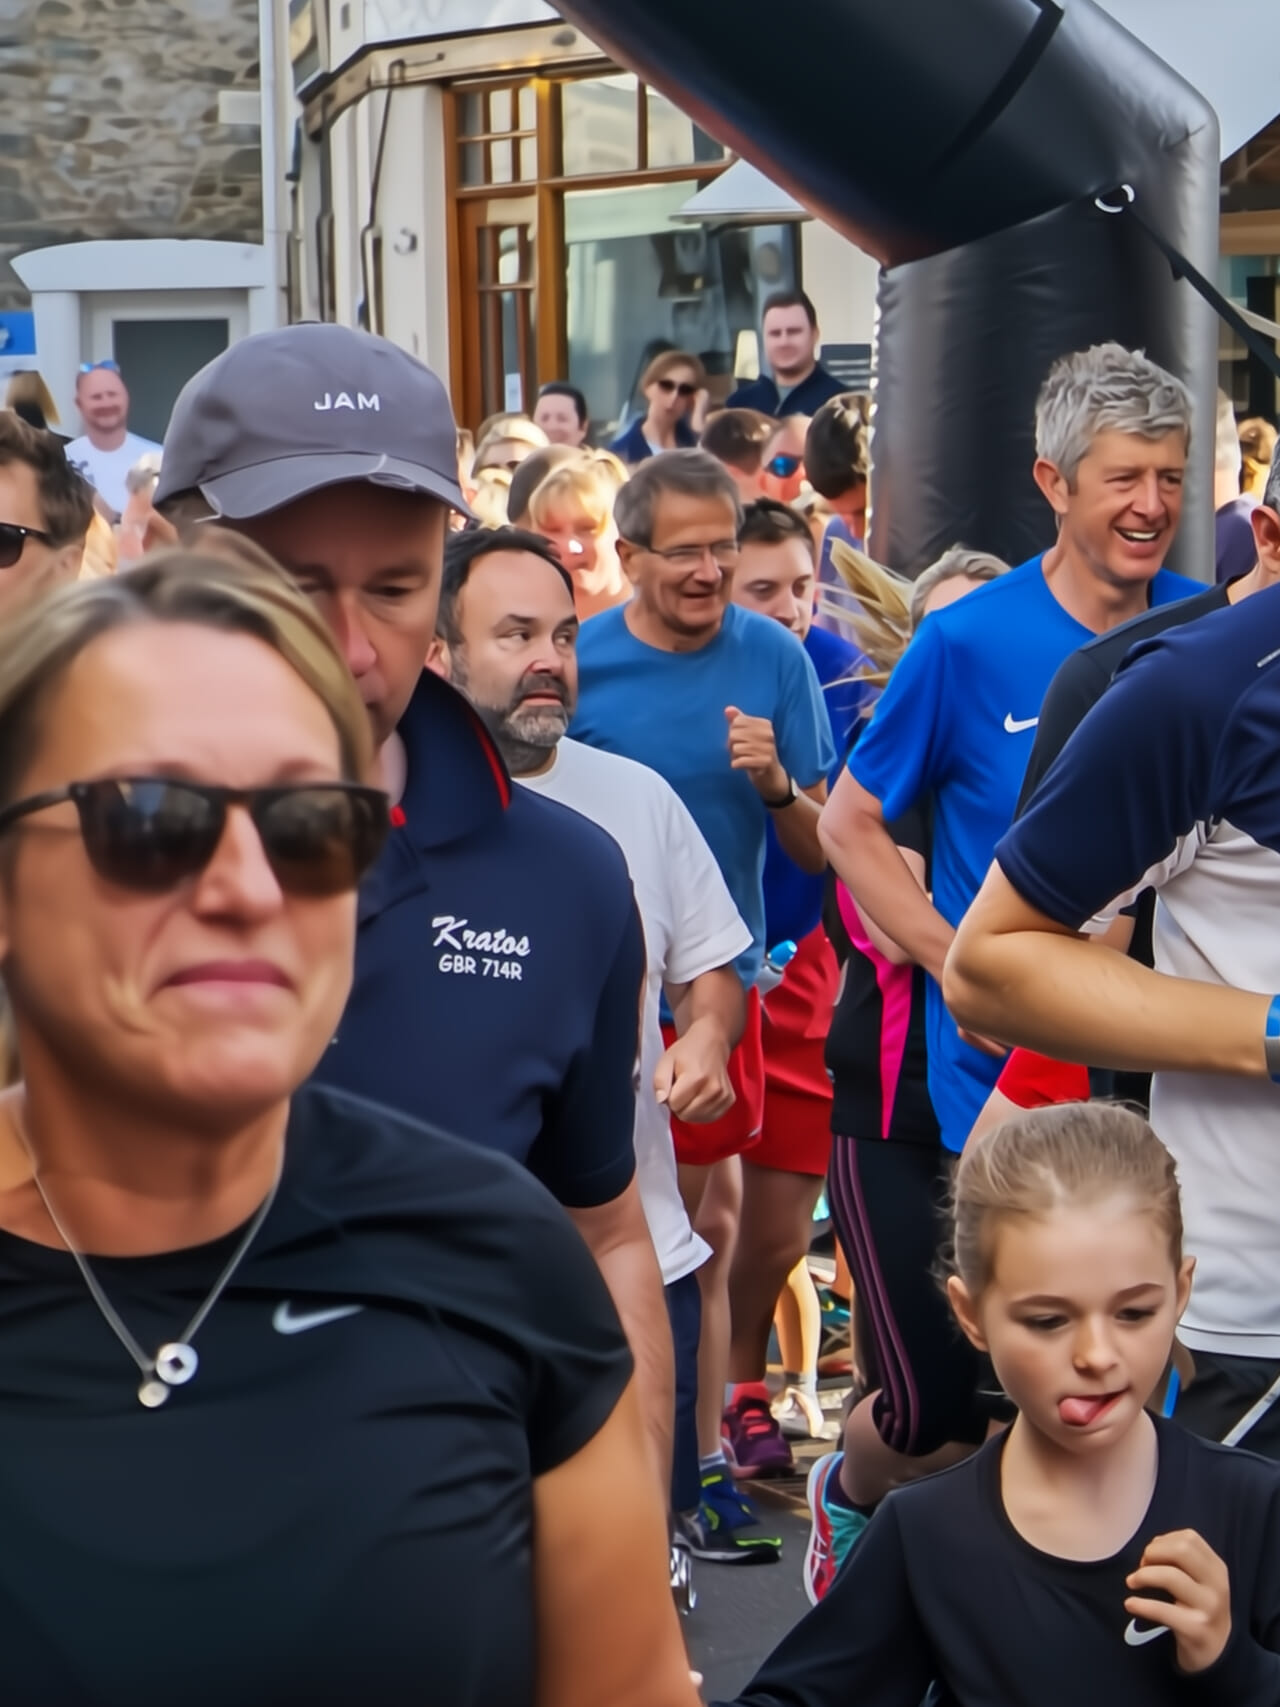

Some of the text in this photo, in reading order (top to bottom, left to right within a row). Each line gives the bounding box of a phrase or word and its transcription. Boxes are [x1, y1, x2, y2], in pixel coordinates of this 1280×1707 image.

[314, 391, 380, 412] JAM
[431, 915, 531, 957] Kratos
[438, 953, 522, 981] GBR 714R
